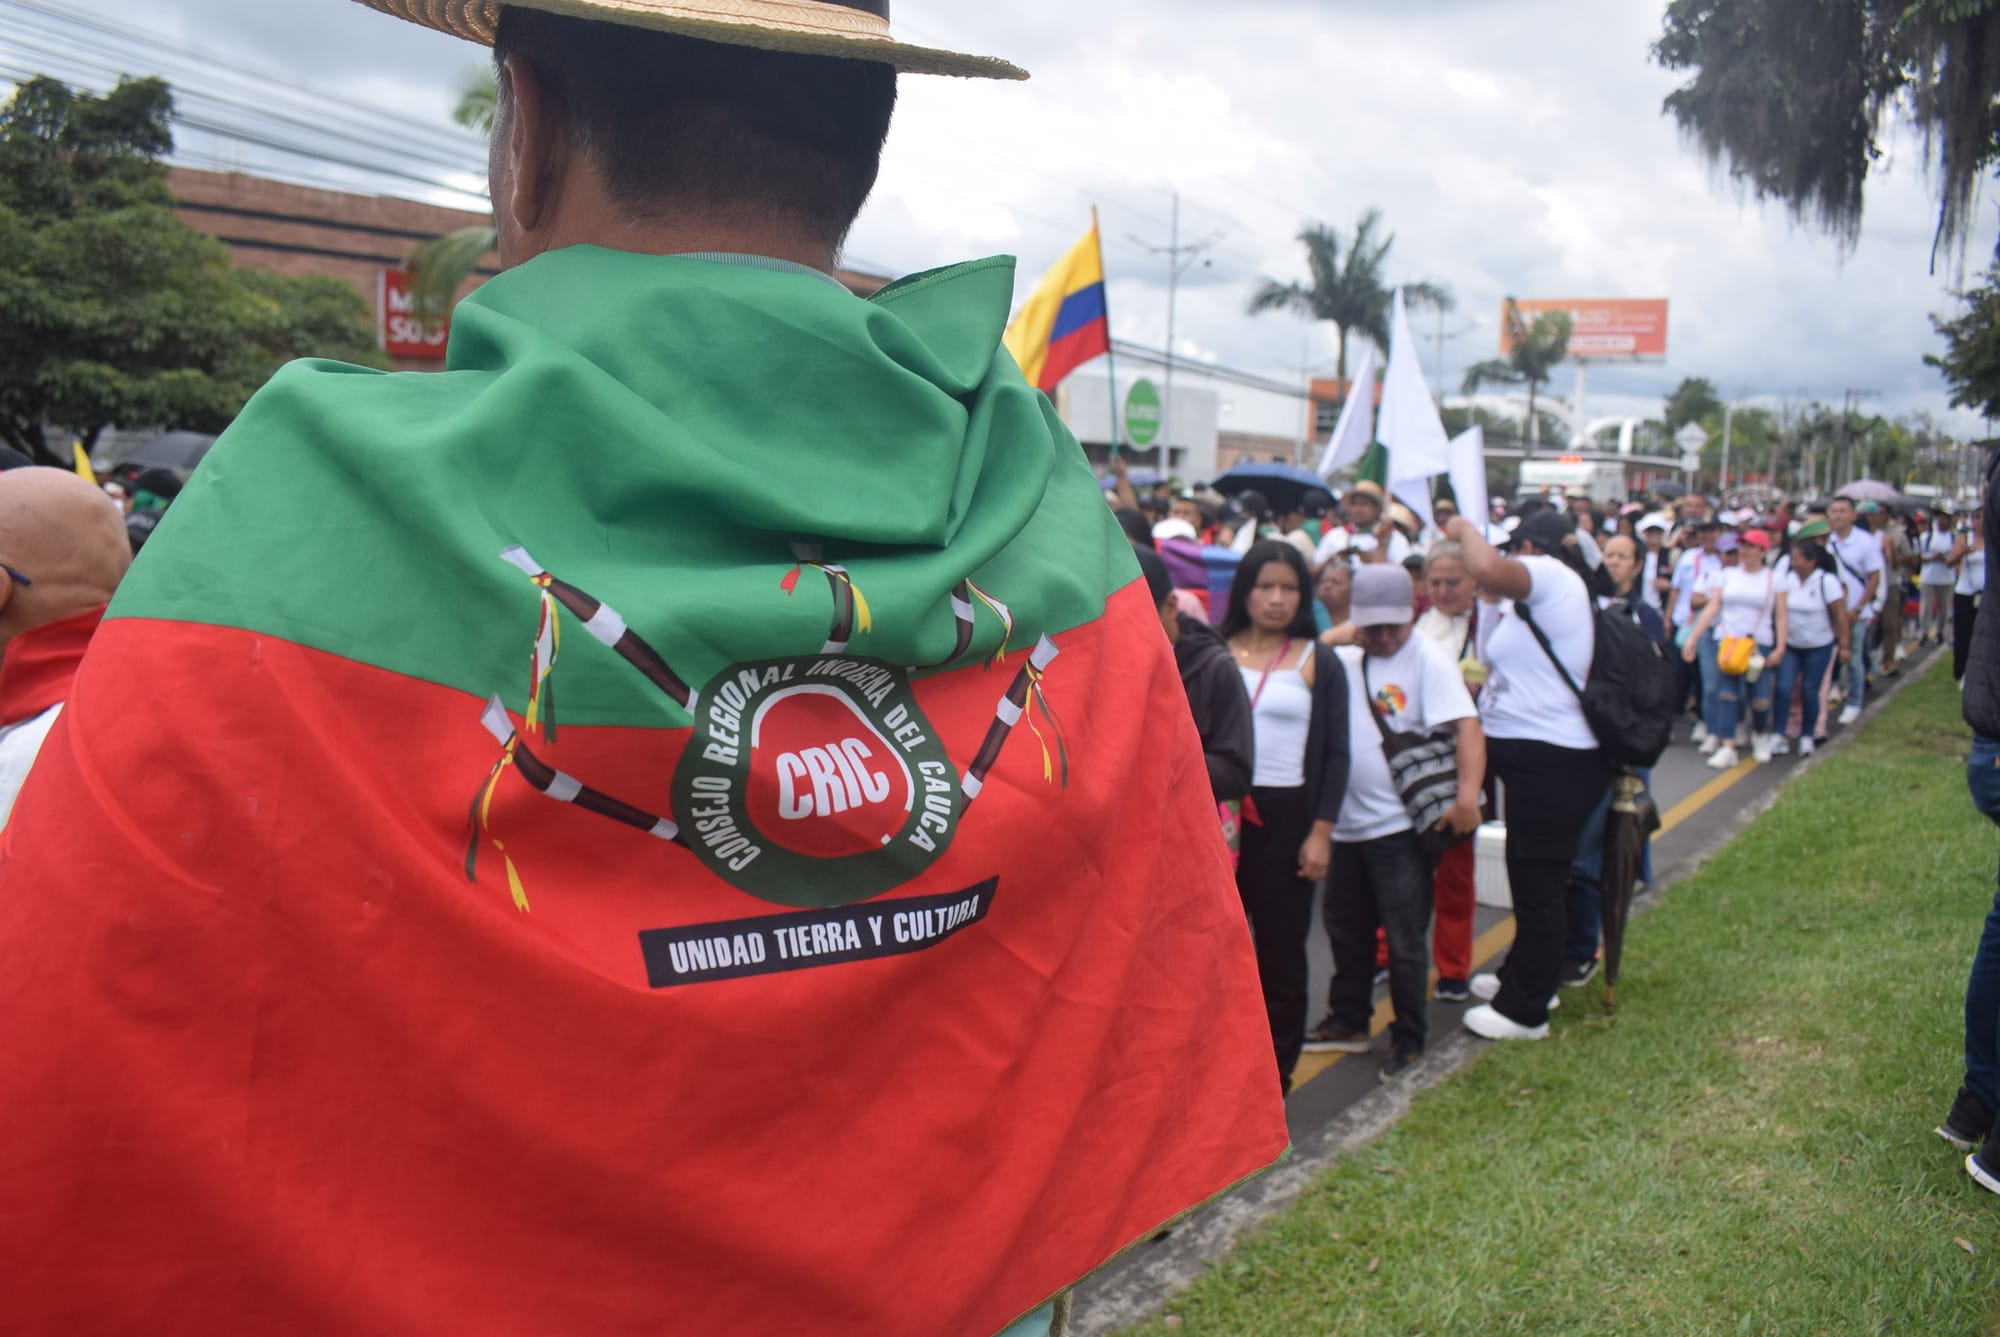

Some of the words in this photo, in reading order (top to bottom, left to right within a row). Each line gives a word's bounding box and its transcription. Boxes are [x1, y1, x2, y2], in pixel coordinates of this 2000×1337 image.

[702, 663, 795, 766] REGIONAL
[883, 703, 926, 753] DEL
[776, 737, 889, 820] CRIC
[909, 761, 952, 853] CAUCA
[691, 776, 761, 872] CONSEJO
[669, 932, 765, 974] UNIDAD
[773, 920, 862, 959] TIERRA
[868, 916, 884, 946] Y
[894, 894, 980, 943] CULTURA
